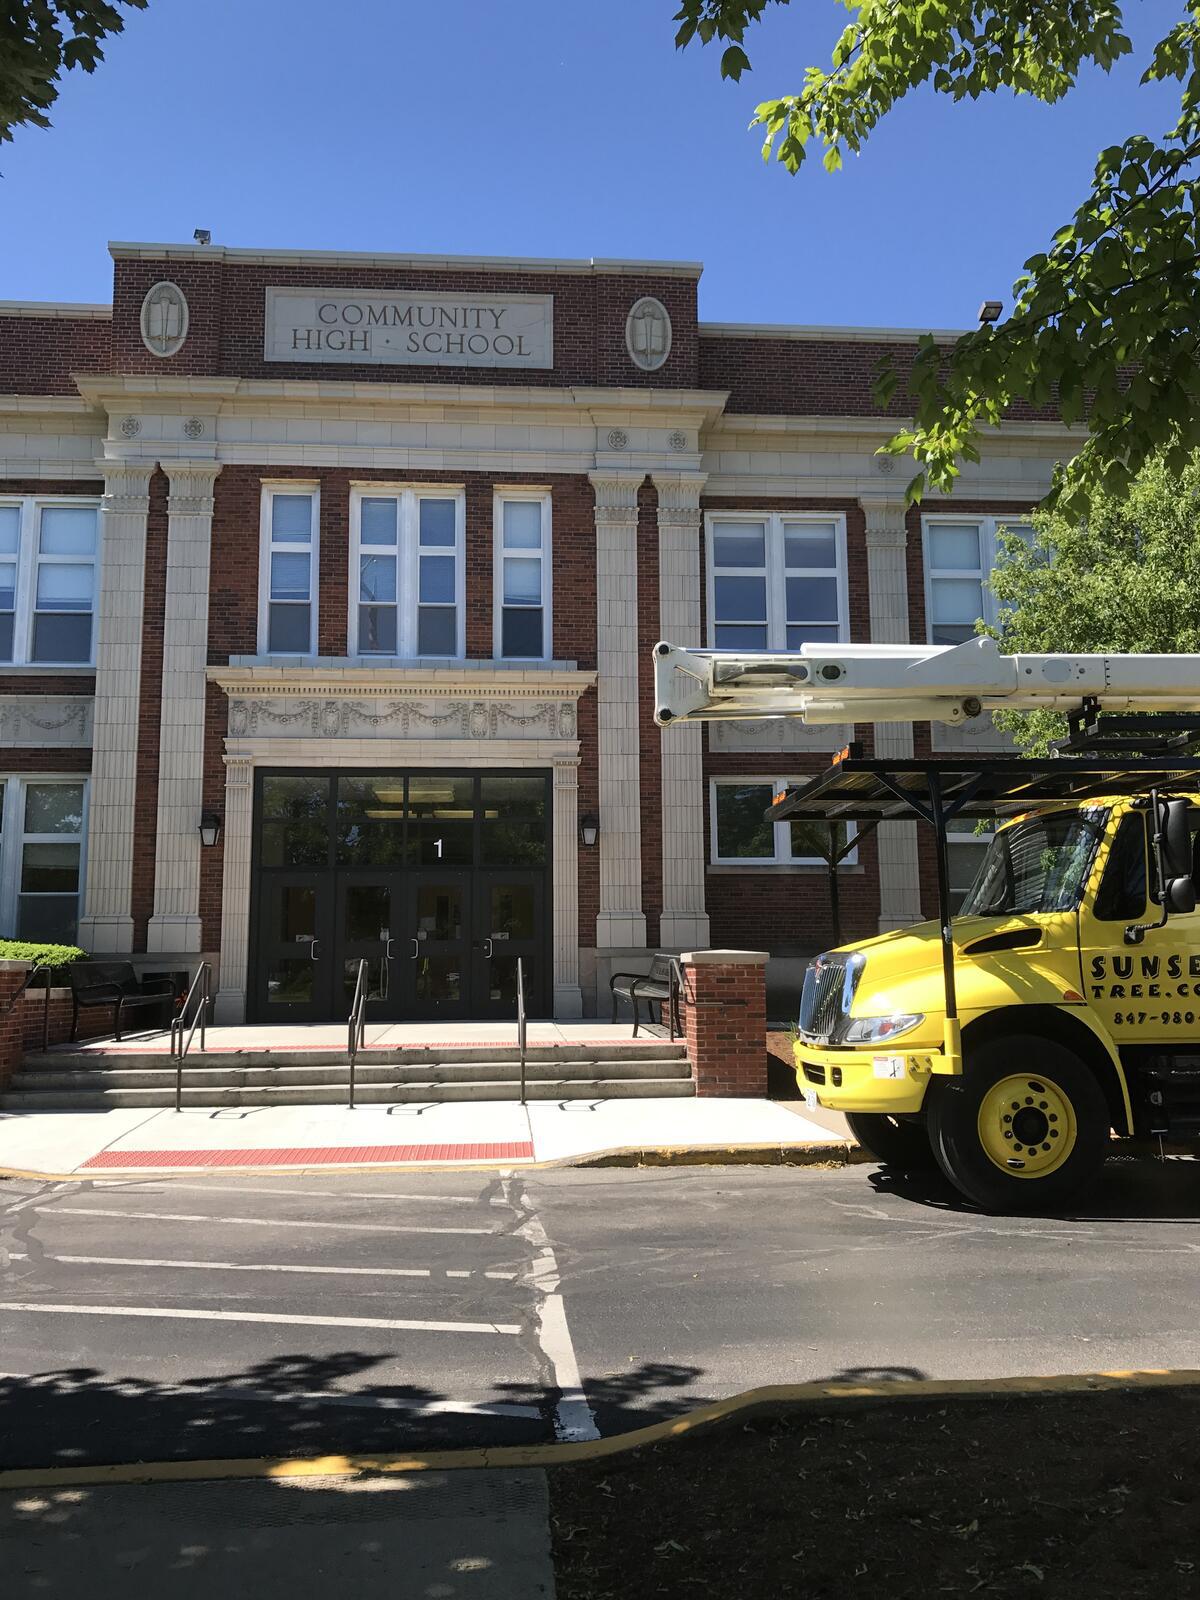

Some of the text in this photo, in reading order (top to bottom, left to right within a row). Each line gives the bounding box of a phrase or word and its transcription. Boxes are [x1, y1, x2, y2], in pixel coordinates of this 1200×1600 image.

[318, 303, 507, 329] COMMUNITY
[291, 328, 531, 356] HIGH SCHOOL
[433, 838, 442, 858] 1
[1091, 954, 1200, 980] SUNSE
[1114, 1011, 1200, 1024] 847-980
